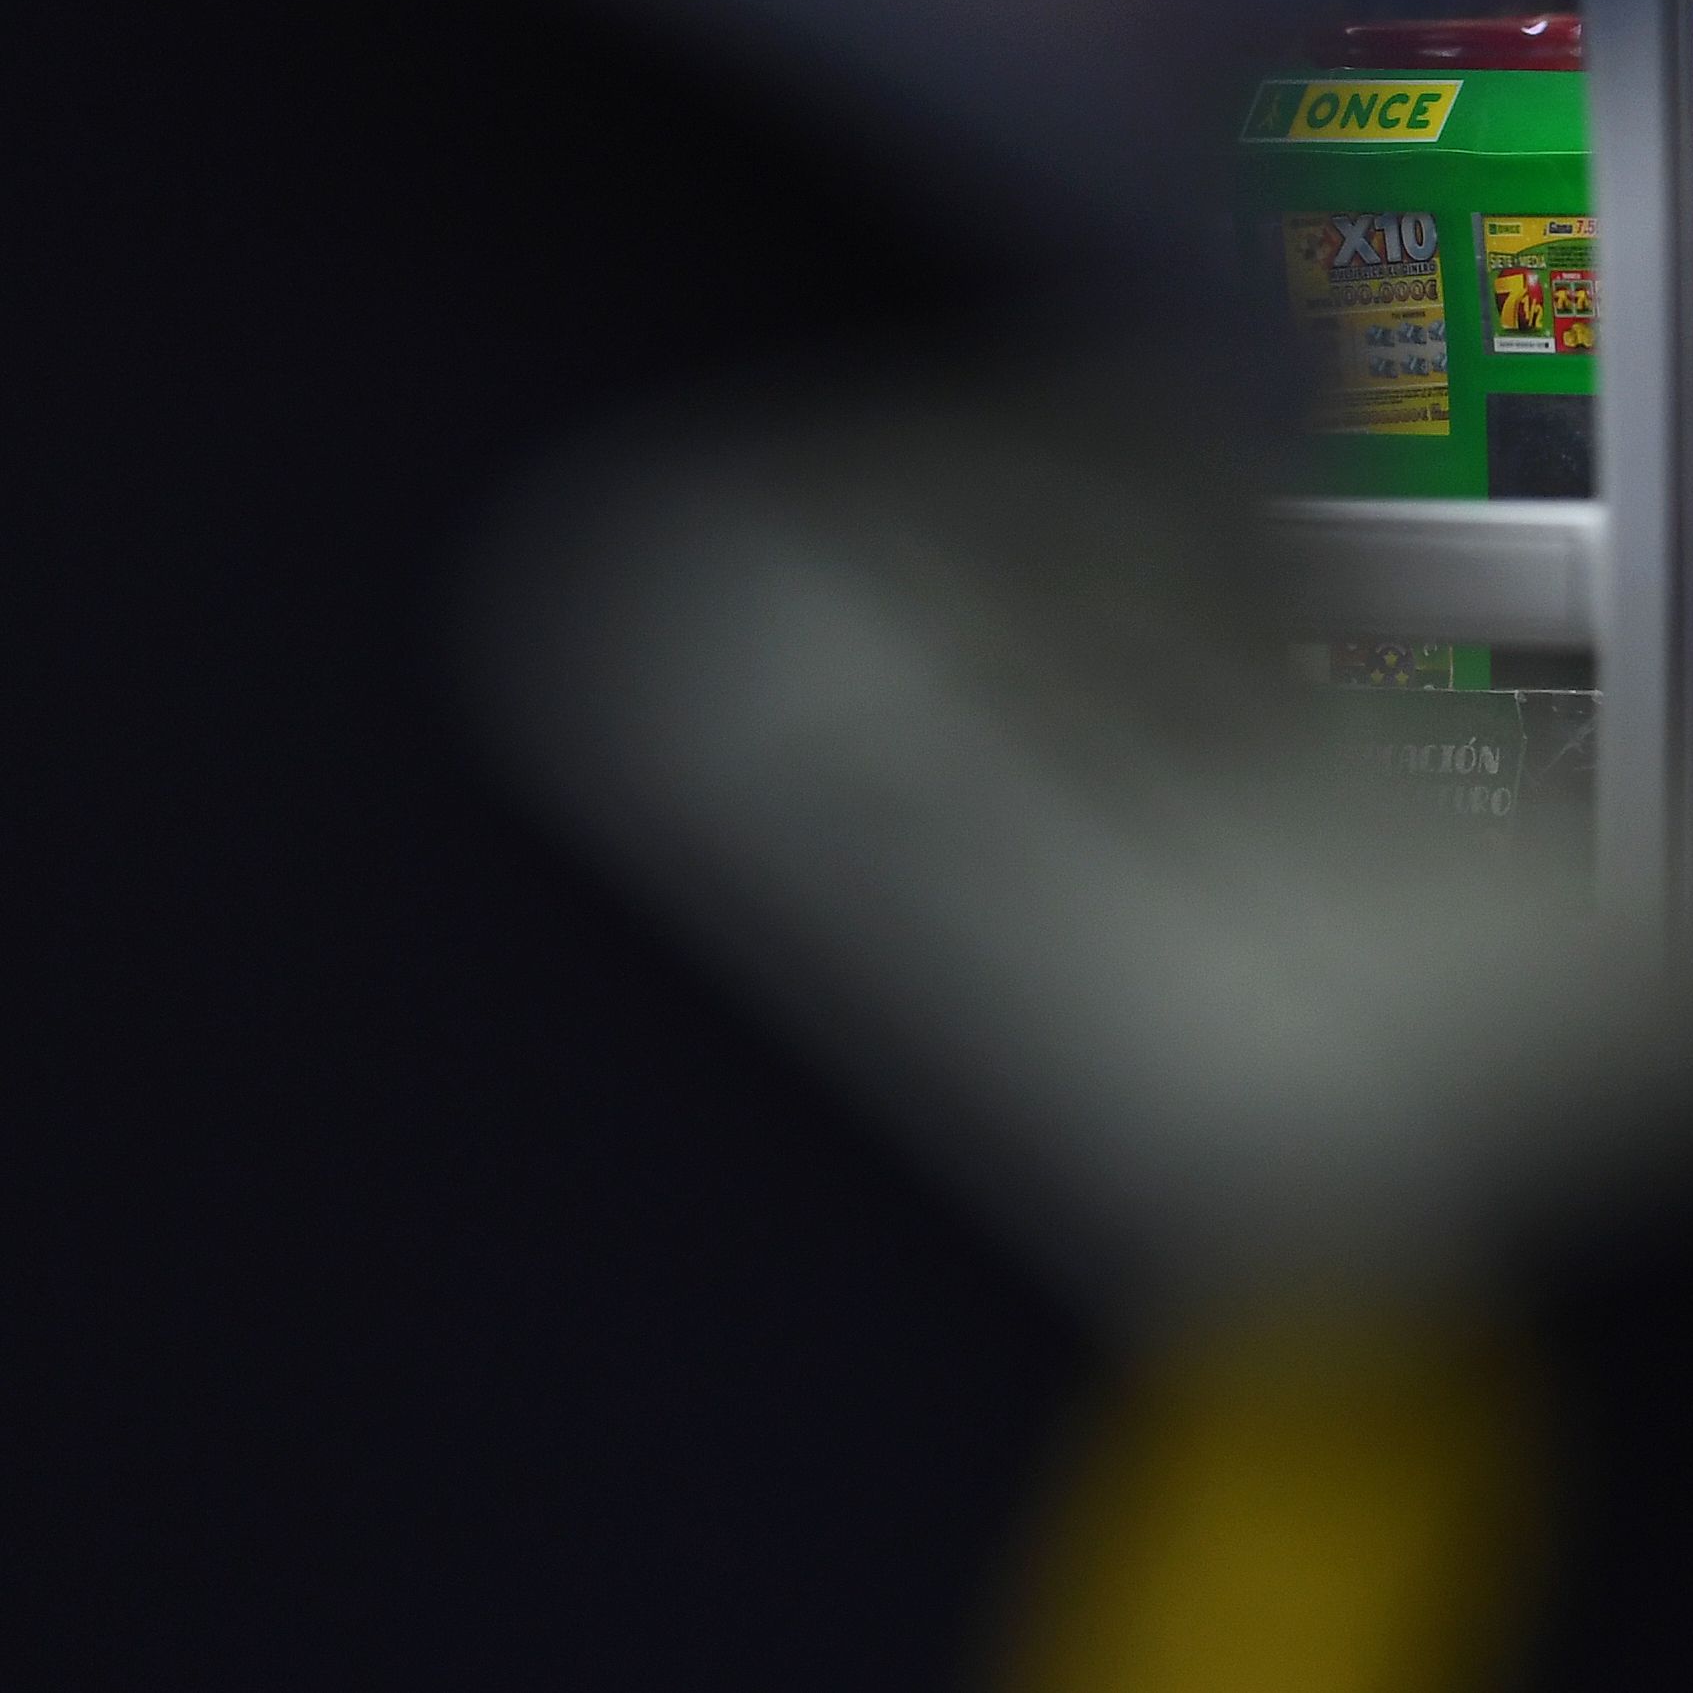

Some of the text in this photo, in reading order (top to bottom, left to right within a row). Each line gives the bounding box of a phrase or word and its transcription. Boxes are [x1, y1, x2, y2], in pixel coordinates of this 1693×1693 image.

[1306, 92, 1442, 129] ONCE
[1331, 211, 1438, 268] X10
[1575, 219, 1598, 235] 7.5
